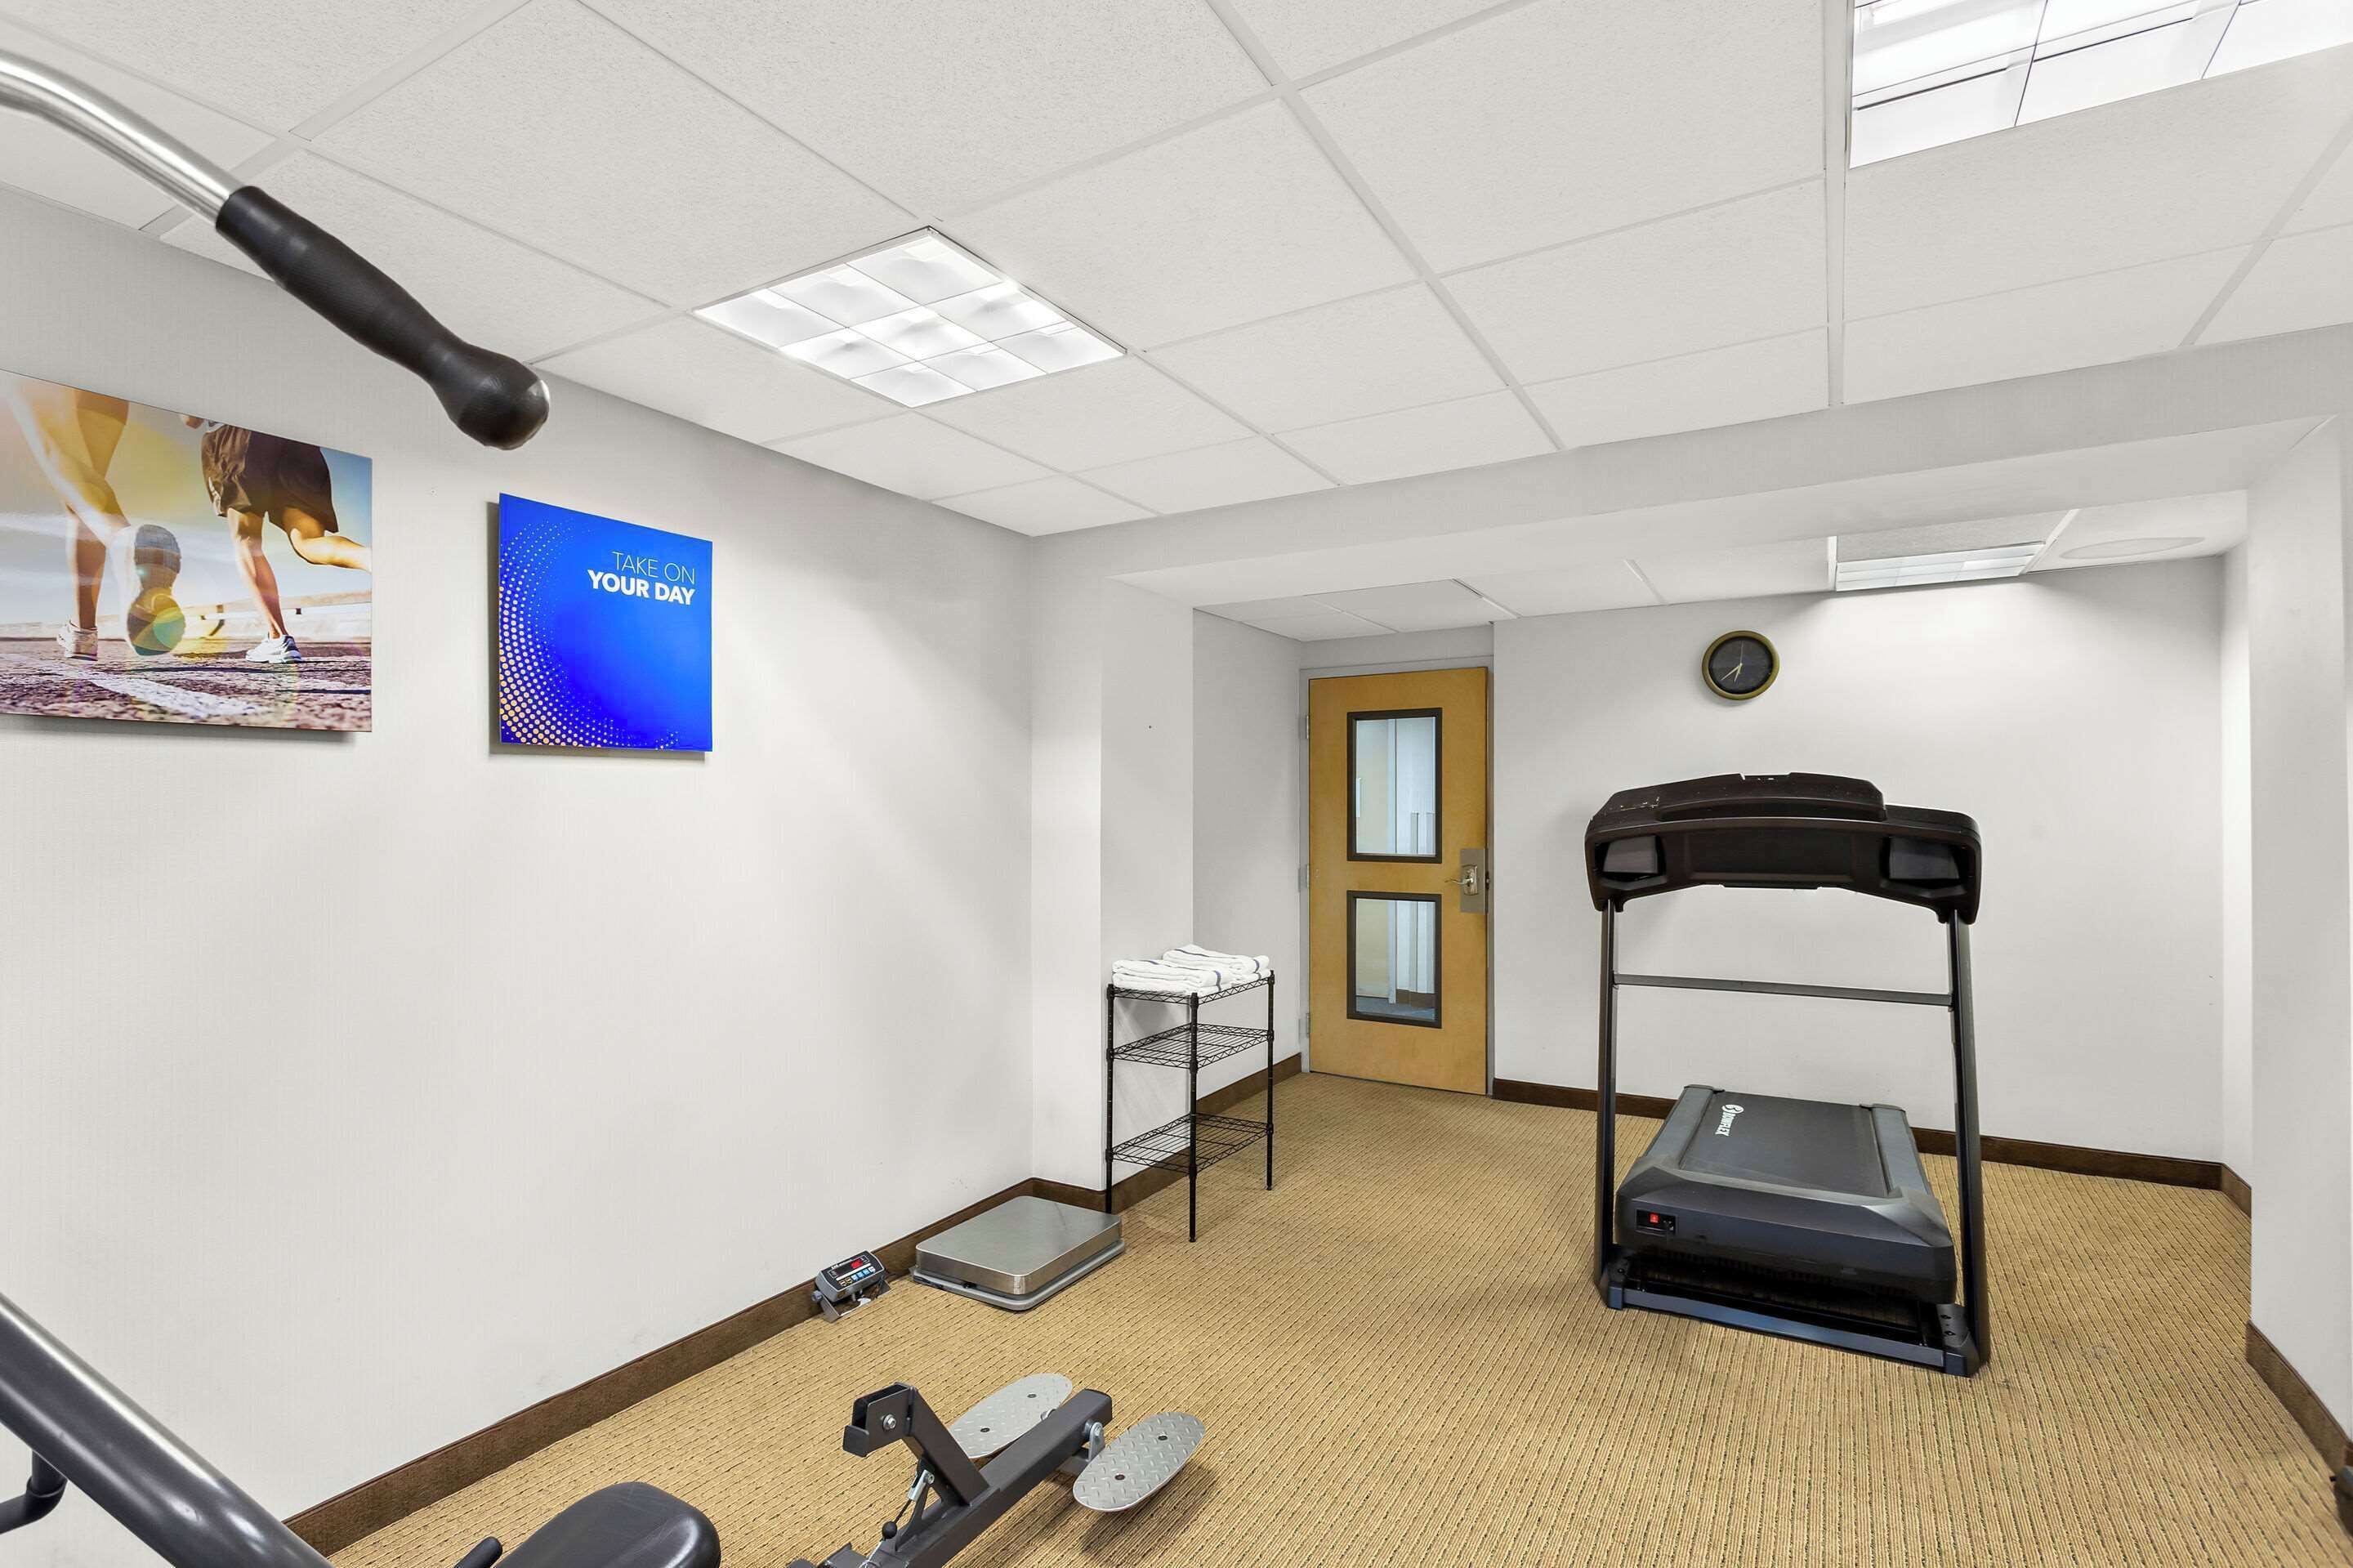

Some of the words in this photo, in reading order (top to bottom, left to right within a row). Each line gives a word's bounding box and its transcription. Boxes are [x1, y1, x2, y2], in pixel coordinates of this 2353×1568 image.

[611, 551, 659, 579] TAKE
[664, 562, 695, 585] ON
[587, 570, 650, 598] YOUR
[654, 582, 695, 605] DAY
